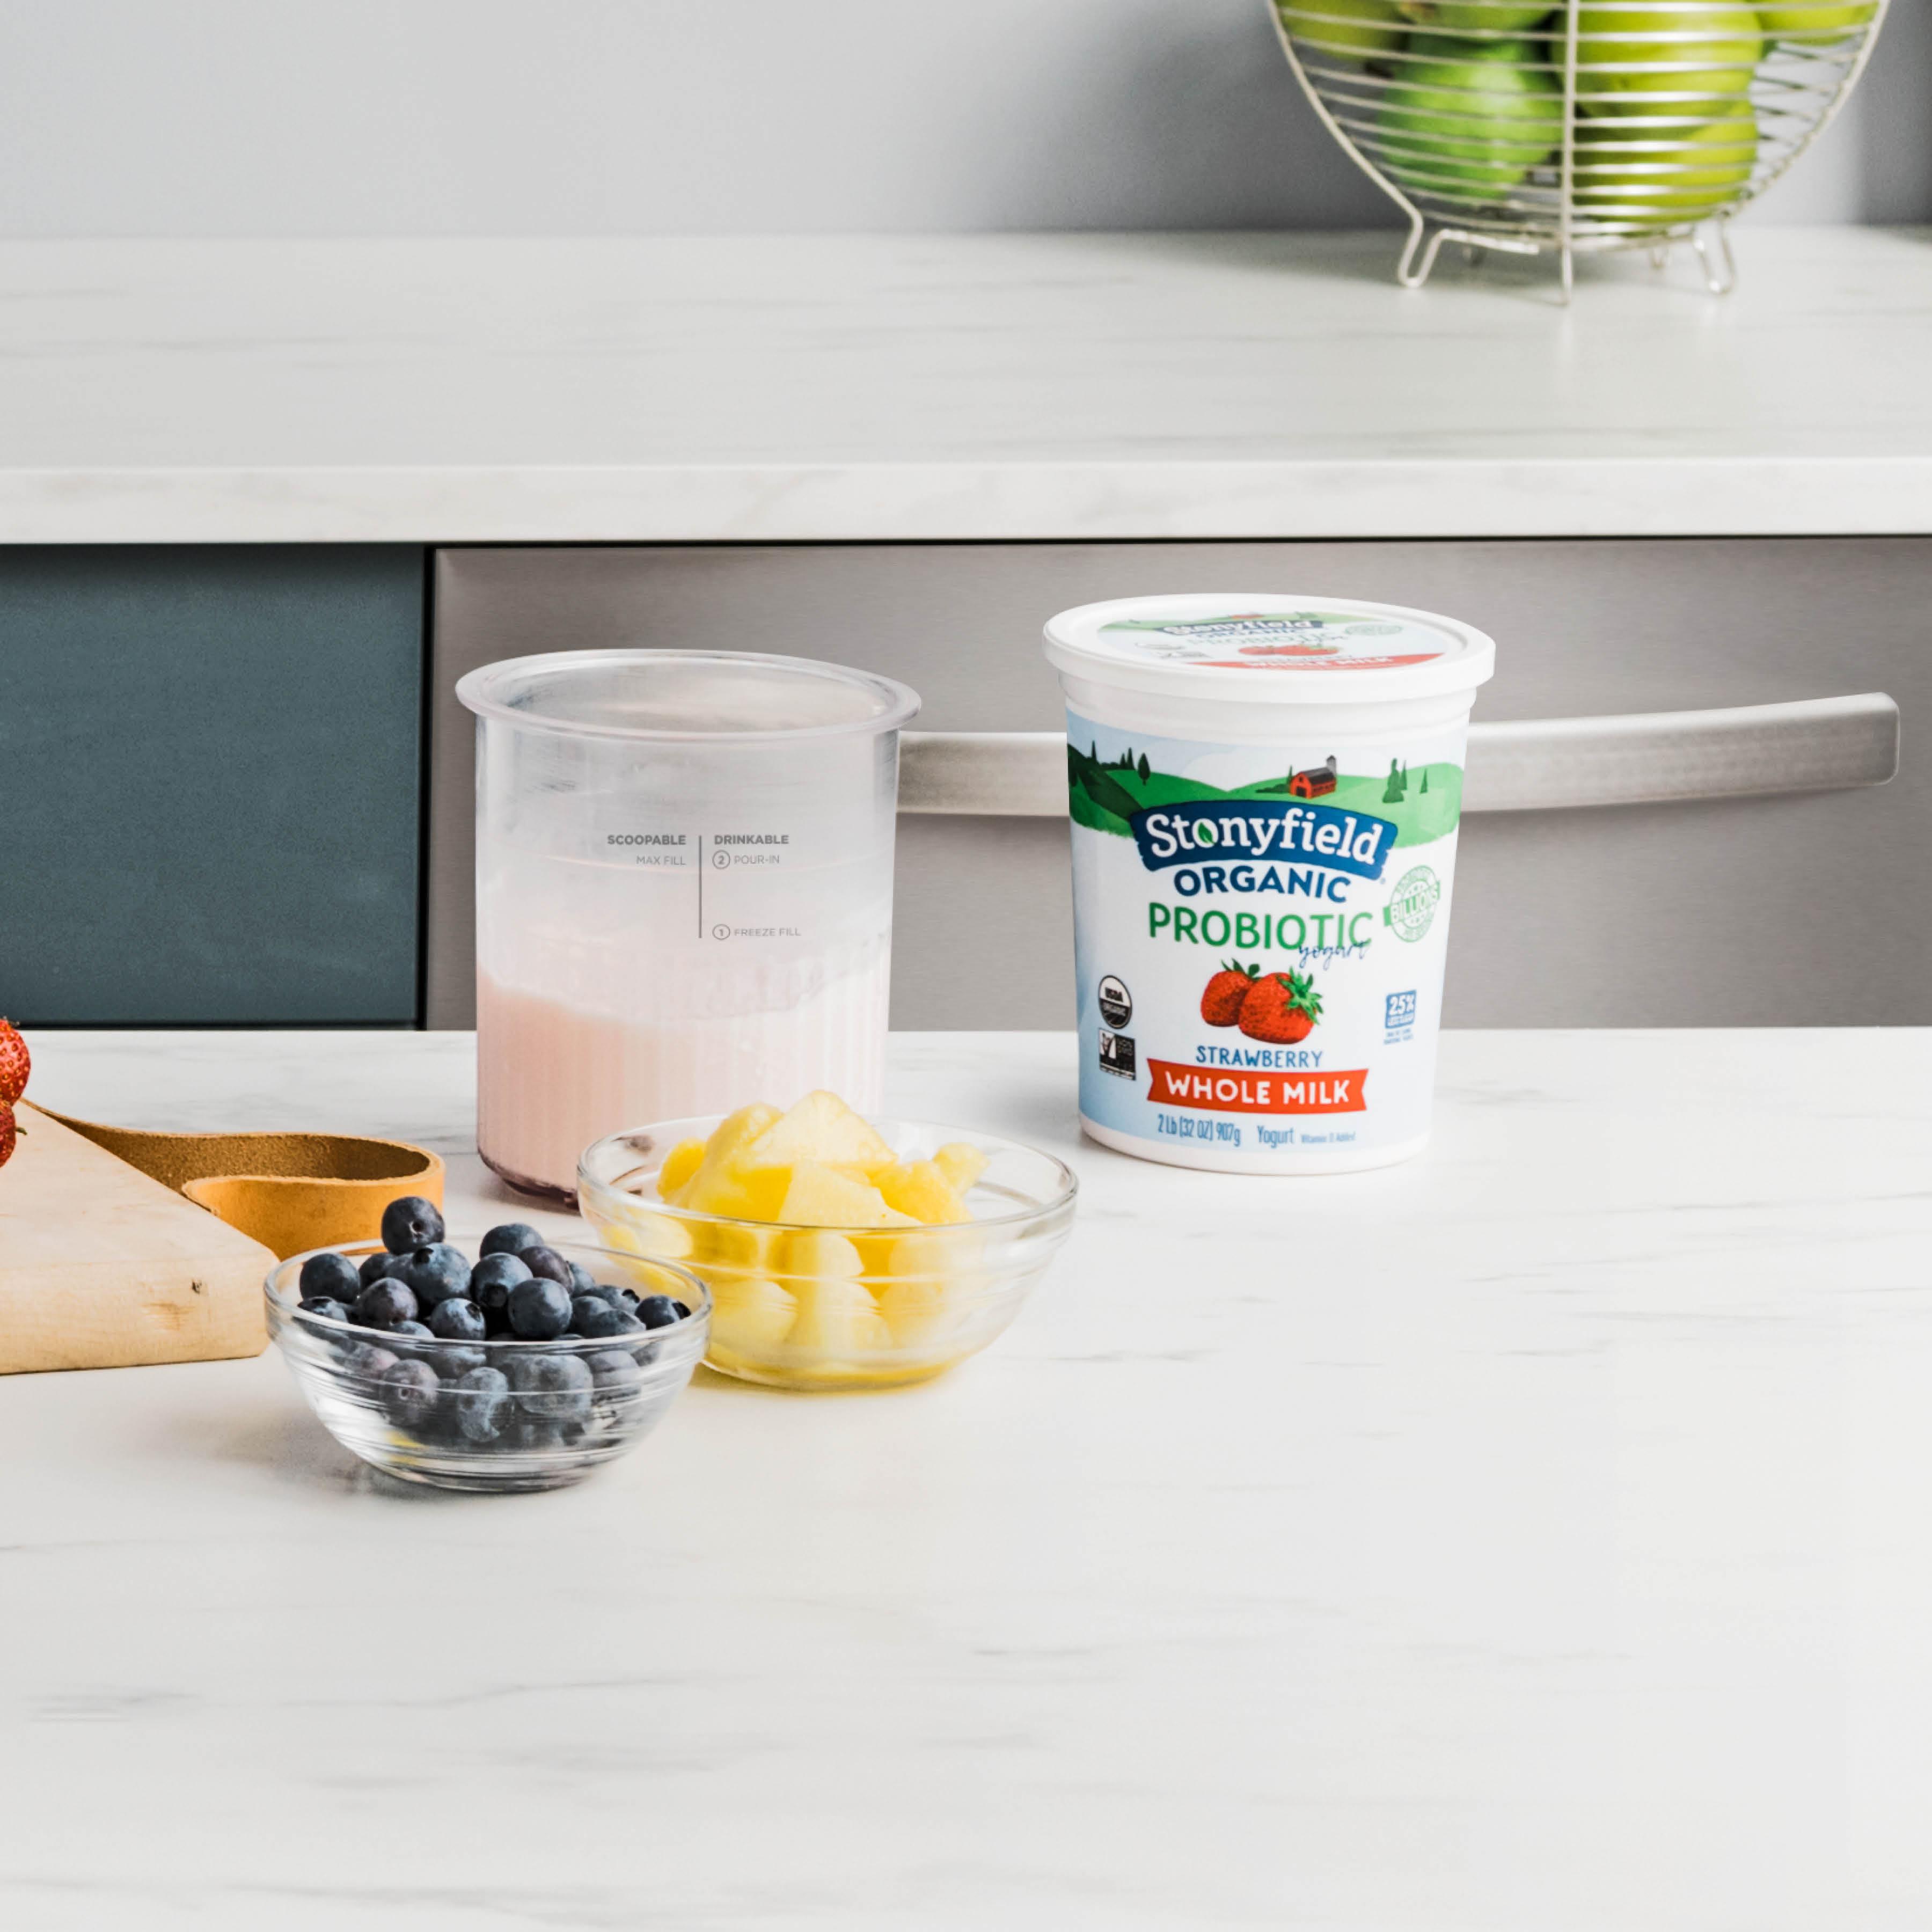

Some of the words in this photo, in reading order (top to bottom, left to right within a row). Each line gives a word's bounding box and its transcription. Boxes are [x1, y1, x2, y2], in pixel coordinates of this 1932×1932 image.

[608, 835, 686, 845] SCOOPABLE
[714, 835, 789, 845] DRINKABLE
[1146, 808, 1383, 864] Stonyfield
[636, 855, 661, 865] MAX
[664, 855, 686, 866] FILL
[734, 855, 780, 865] POUR-IN
[1174, 866, 1351, 903] ORGANIC
[734, 928, 776, 937] FREEZE
[779, 928, 801, 937] FILL
[1149, 902, 1373, 950] PROBIOTIC
[1299, 940, 1372, 970] yogurt
[1196, 1045, 1323, 1067] STRAWBERRY
[1165, 1071, 1271, 1104] WHOLE
[1283, 1079, 1350, 1105] MILK
[1158, 1113, 1164, 1133] 2
[1180, 1116, 1195, 1138] (32
[1216, 1122, 1241, 1147] 907g
[1257, 1125, 1294, 1148] Yogurt
